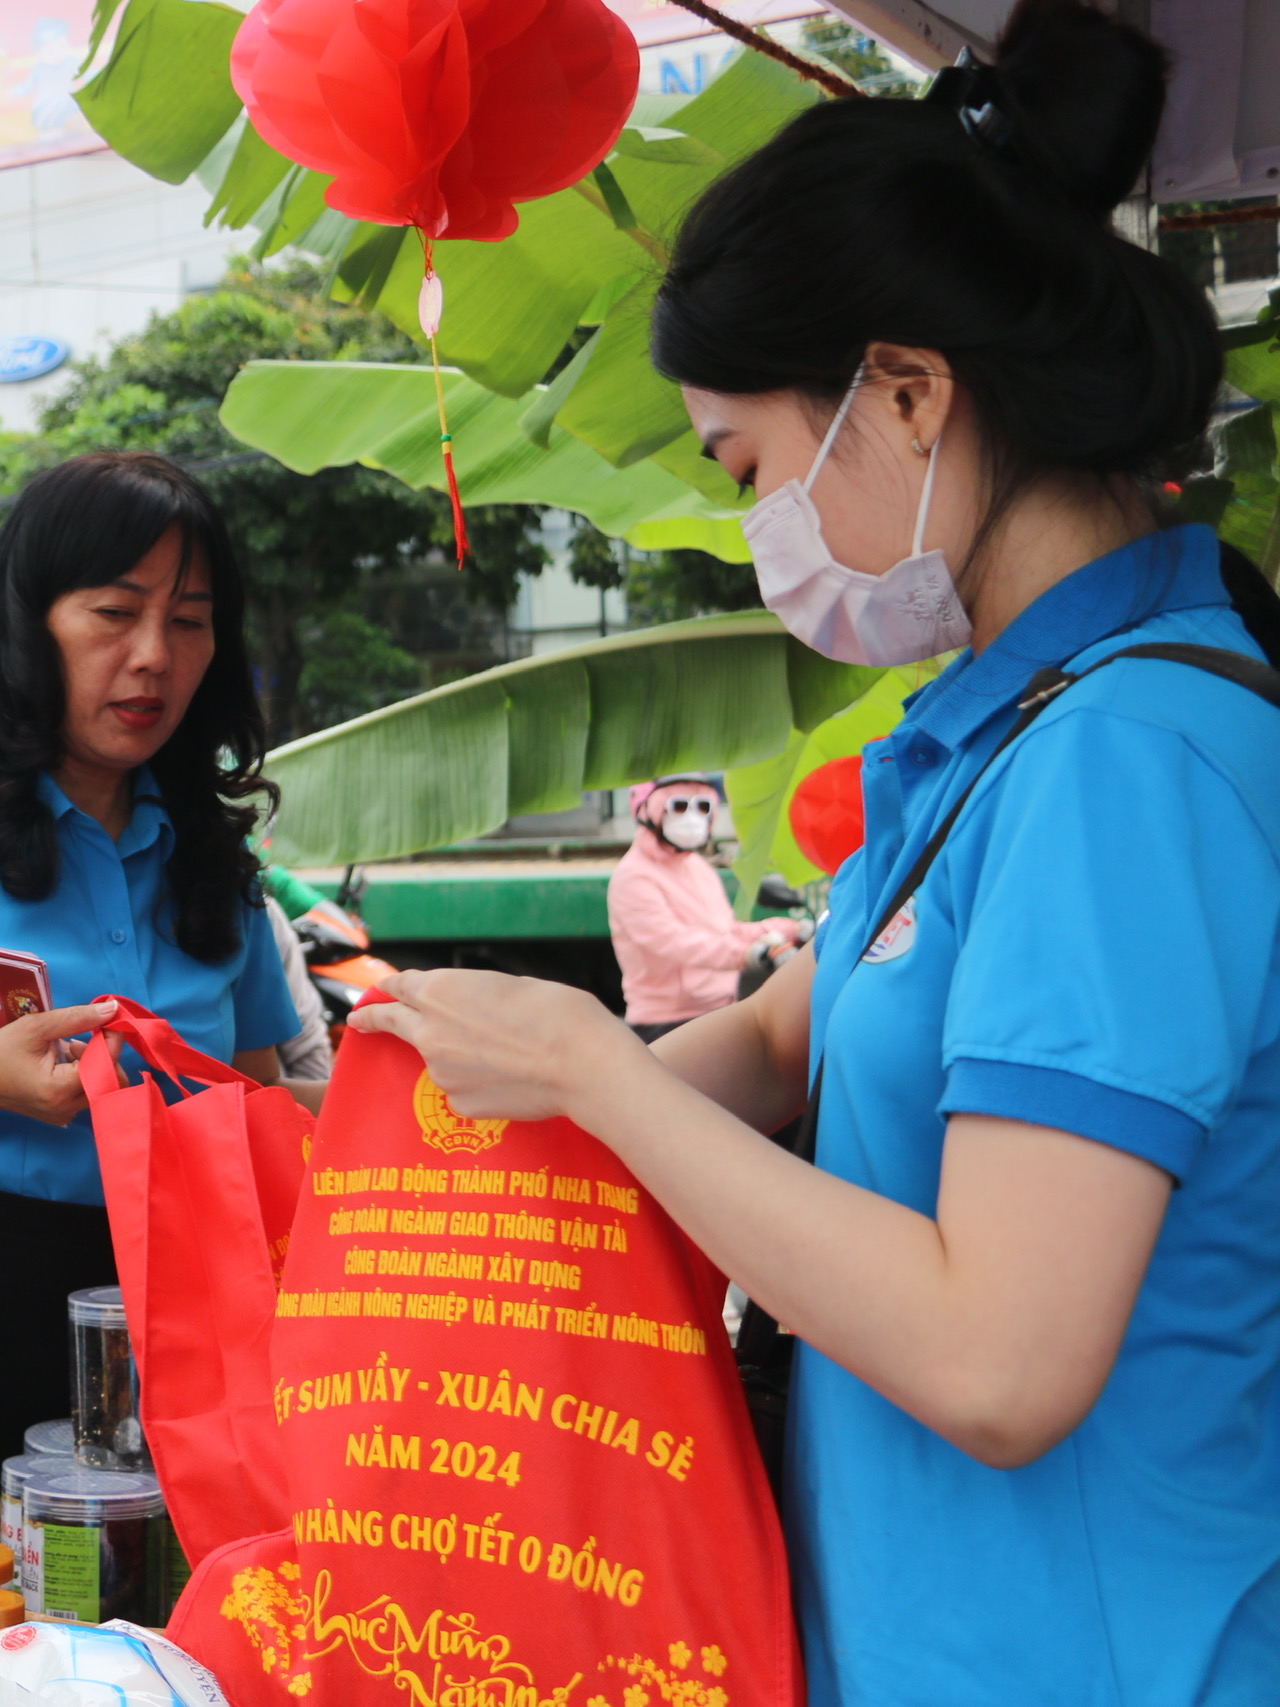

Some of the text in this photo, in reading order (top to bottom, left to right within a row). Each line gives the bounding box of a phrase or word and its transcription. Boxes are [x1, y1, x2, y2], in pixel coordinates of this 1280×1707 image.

[313, 1167, 344, 1195] LIÊN
[371, 1166, 399, 1191] LAO
[402, 1162, 448, 1198] ĐỘNG
[452, 1164, 505, 1195] THÀNH
[509, 1165, 549, 1198] PHỐ
[552, 1175, 591, 1204] NHA
[596, 1180, 639, 1214] TRANG
[329, 1203, 628, 1253] CÔNG ĐOÀN NGÀNH GIAO THÔNG VẬN TẢI
[344, 1245, 581, 1292] CÔNG ĐOÀN NGÀNH XÂY DỰNG
[275, 1286, 706, 1356] ÔNG ĐOÀN NGÀNH NÔNG NGHIỆP VÀ PHÁT TRIỂN NÔNG THÔN
[274, 1351, 695, 1482] ẾT SUM VẦY - XUÂN CHIA SẺ
[345, 1424, 521, 1487] NĂM 2024
[306, 1498, 384, 1547] HÀNG
[390, 1513, 458, 1565] CHỢ
[462, 1512, 515, 1566] TẾT
[547, 1536, 645, 1607] ĐỒNG
